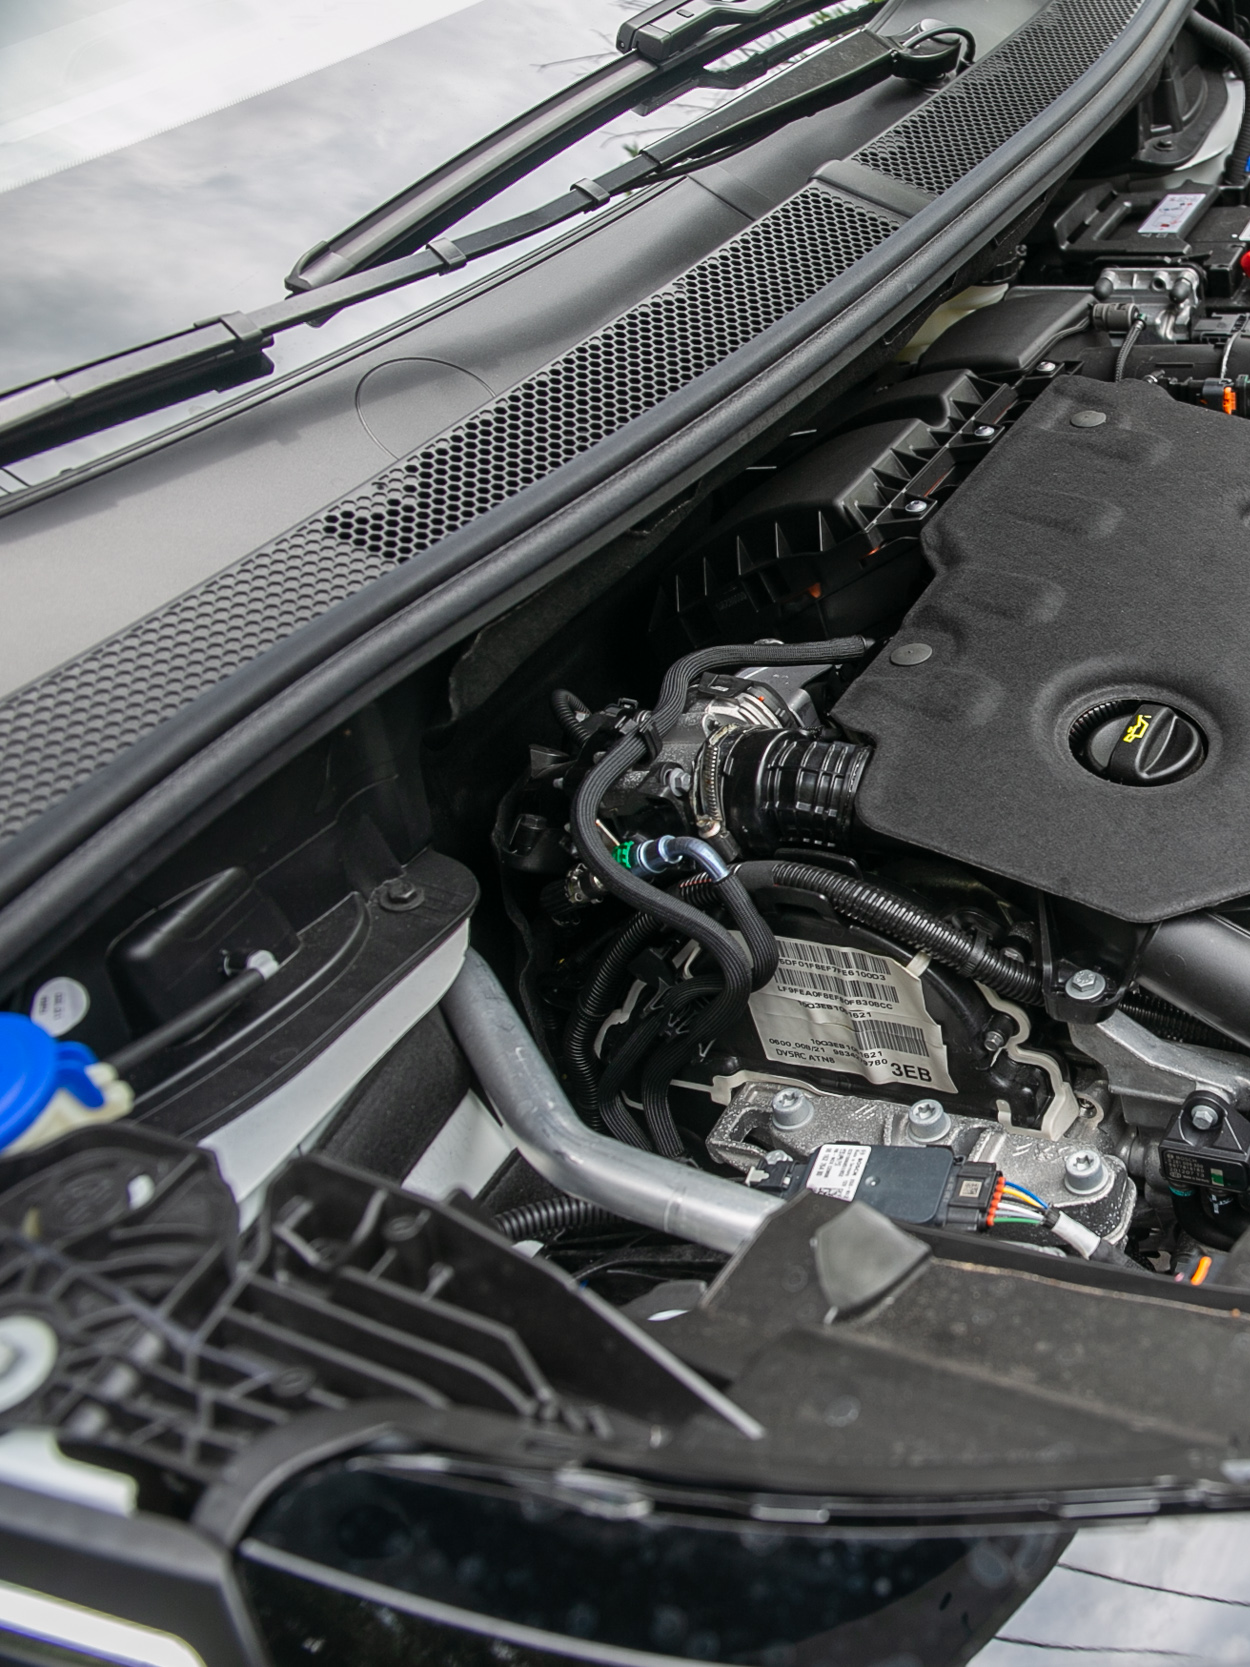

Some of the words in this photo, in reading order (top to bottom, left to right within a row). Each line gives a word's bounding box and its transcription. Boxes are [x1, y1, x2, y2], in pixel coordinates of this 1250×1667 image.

[775, 1048, 807, 1060] DV5RC
[808, 1054, 836, 1064] ATN8
[890, 1062, 932, 1083] 3EB
